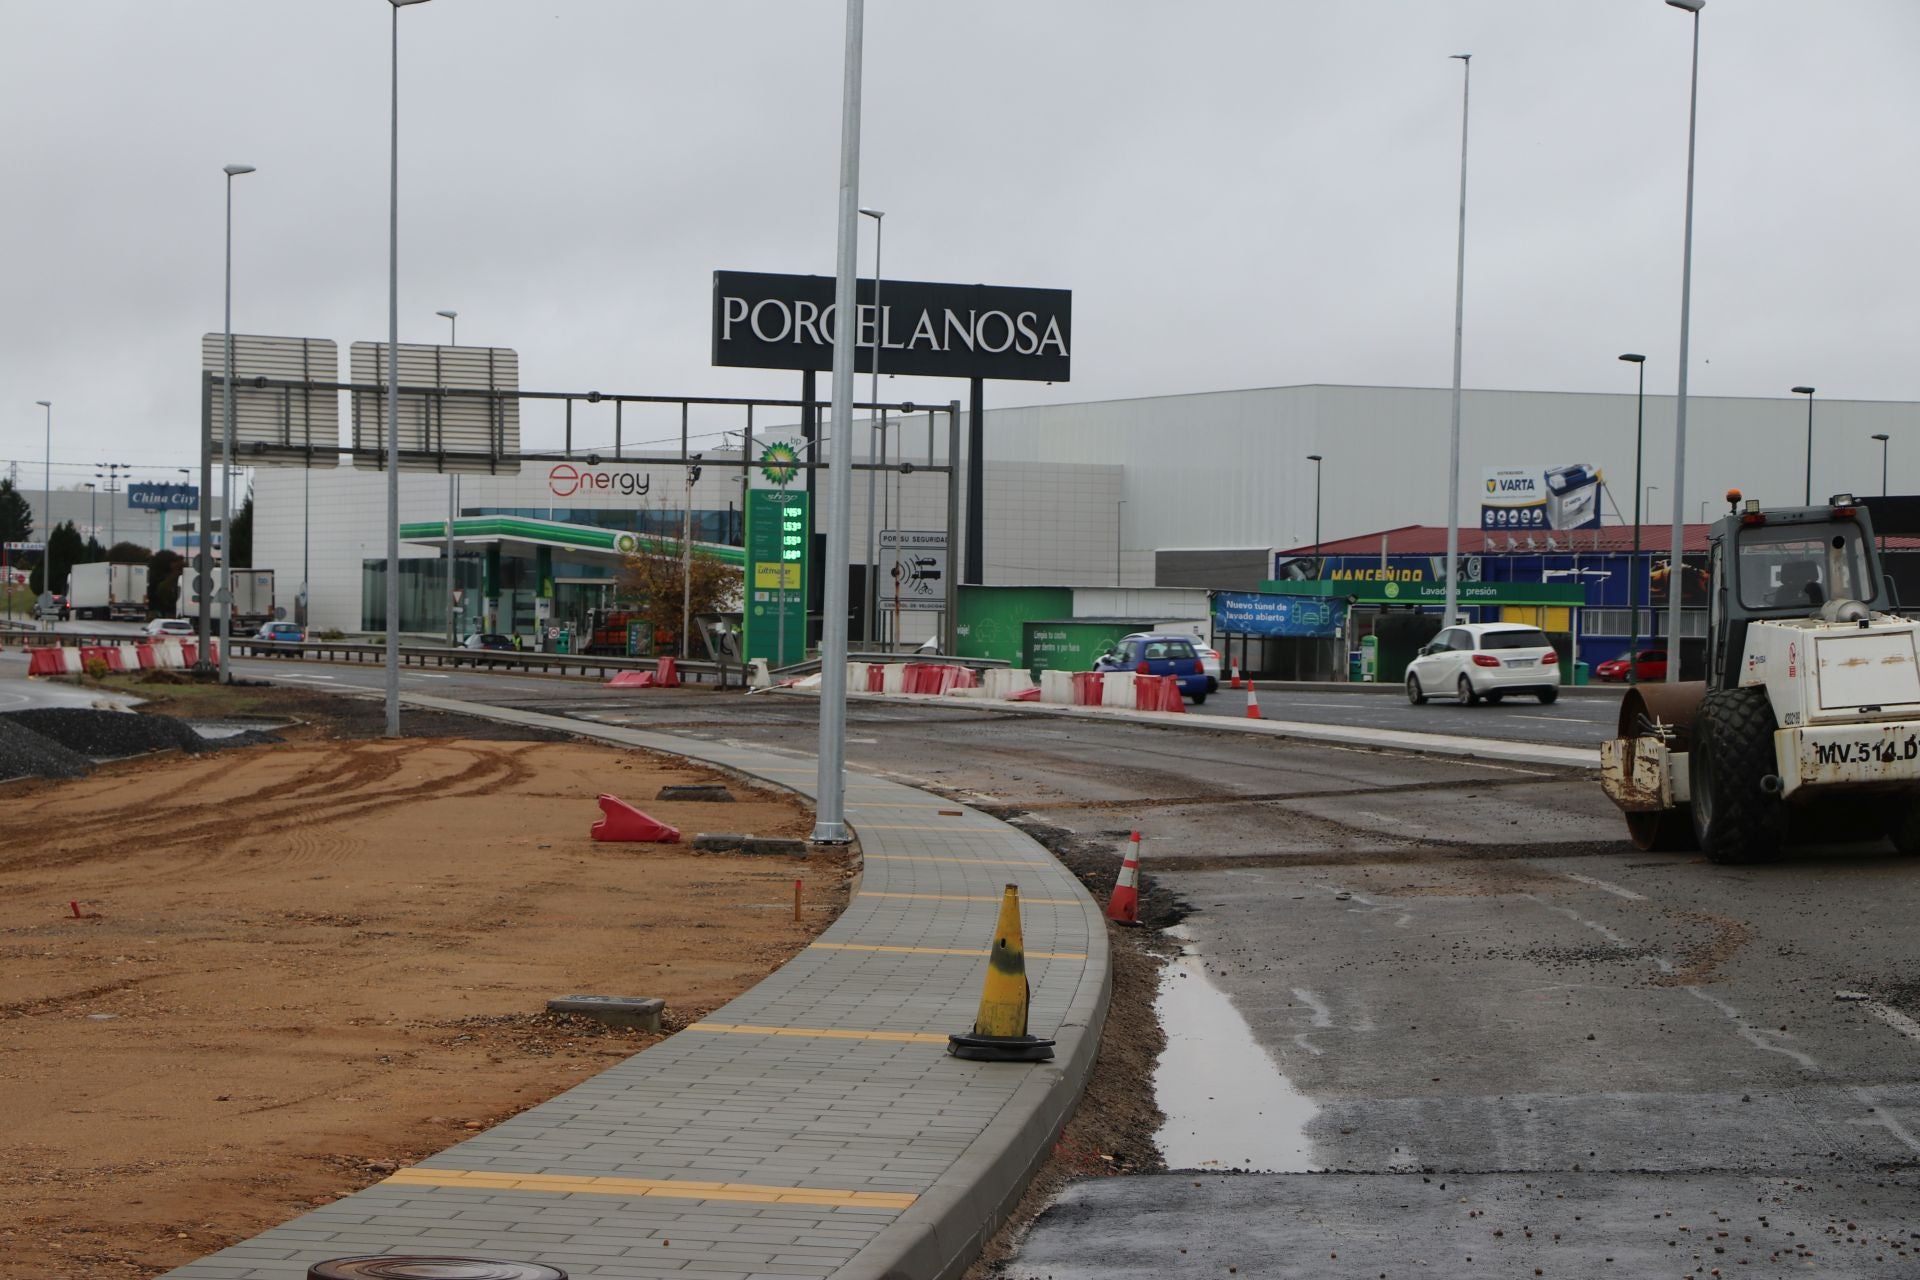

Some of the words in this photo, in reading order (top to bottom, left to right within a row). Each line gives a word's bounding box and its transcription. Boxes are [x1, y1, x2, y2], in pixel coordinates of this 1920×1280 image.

[1500, 479, 1535, 491] VARTA
[132, 492, 168, 503] China
[171, 493, 197, 506] City
[1331, 566, 1423, 582] MANCEÑIDO
[1466, 586, 1497, 597] presión
[1226, 600, 1253, 610] Nuevo
[1255, 602, 1275, 611] túnel
[1276, 603, 1287, 611] de
[1226, 611, 1254, 620] lavado
[1255, 612, 1285, 622] abierto
[1819, 741, 1920, 764] MV.514.D
